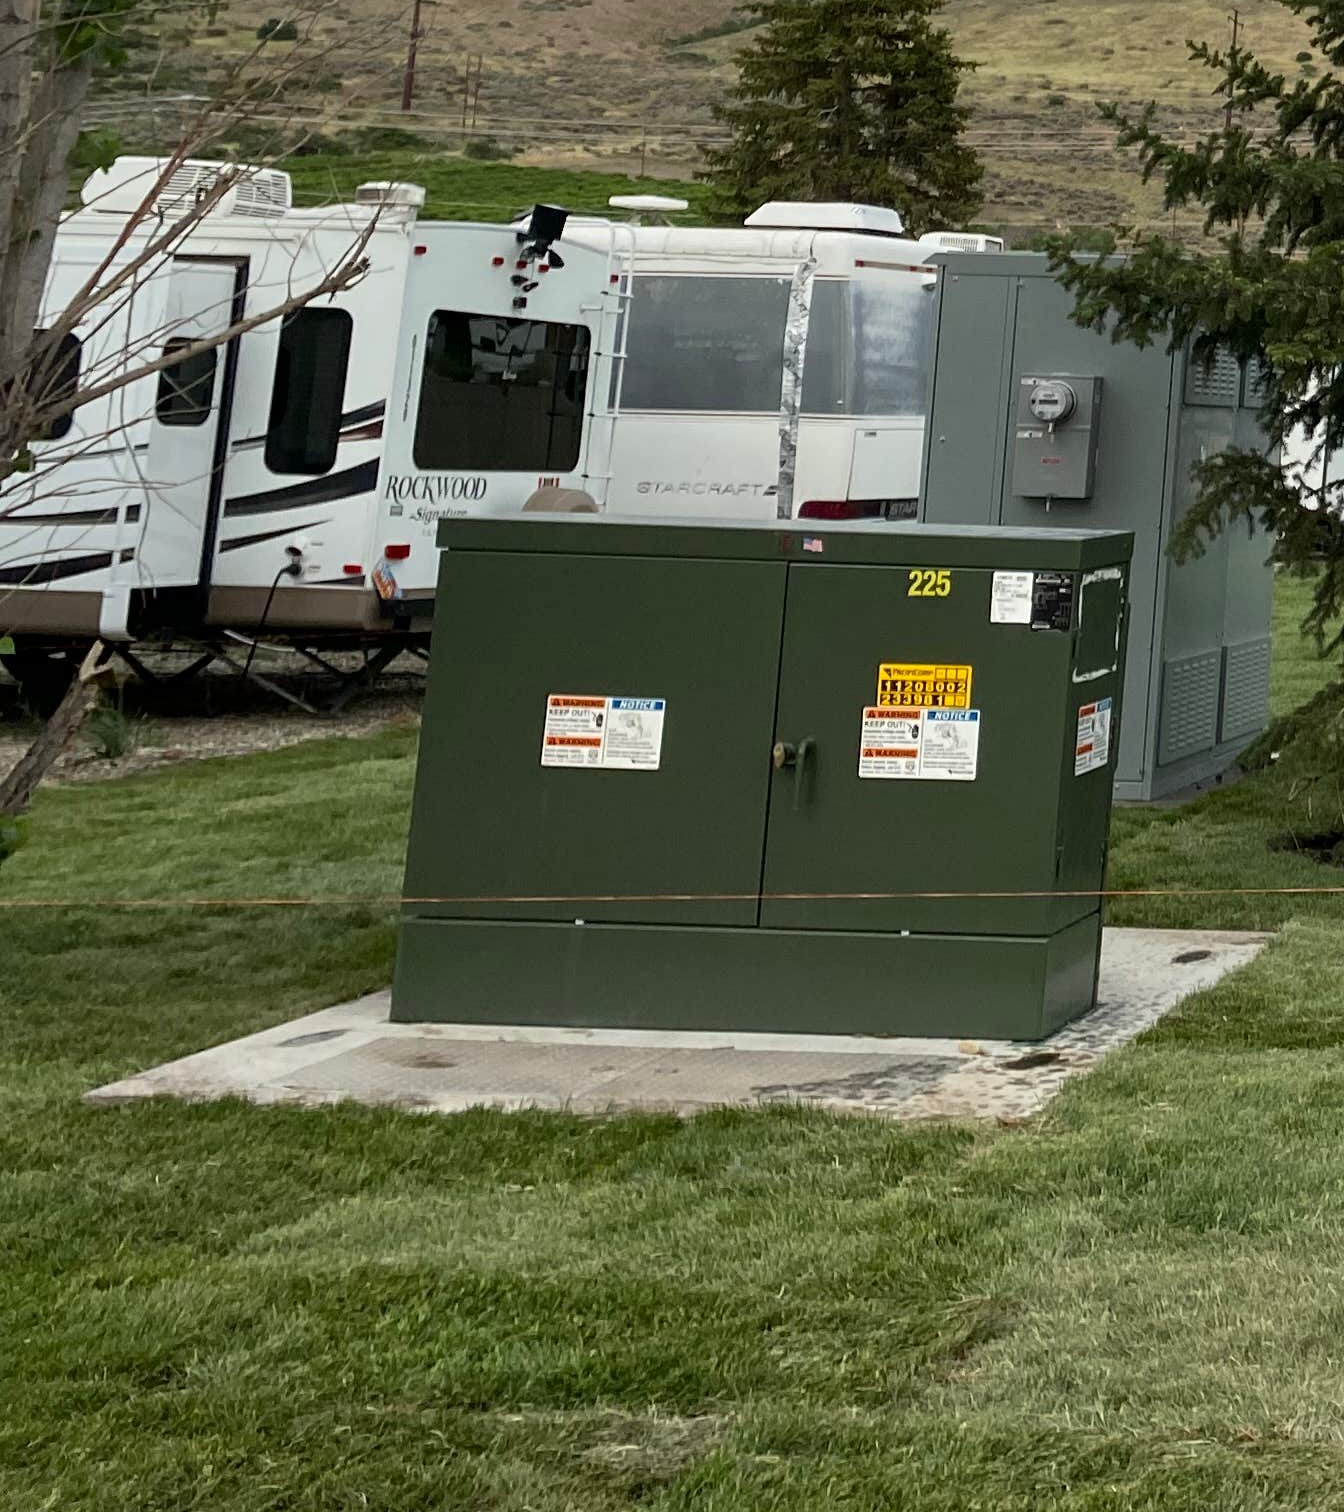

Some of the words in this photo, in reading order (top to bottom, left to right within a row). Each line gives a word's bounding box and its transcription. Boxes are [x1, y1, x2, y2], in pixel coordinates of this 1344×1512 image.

[385, 474, 487, 505] ROCKWOOD
[636, 482, 764, 497] STARCRAFT
[908, 570, 951, 597] 225
[620, 699, 653, 709] NOTICE
[878, 711, 919, 719] WARNING
[934, 711, 971, 721] NOTICE
